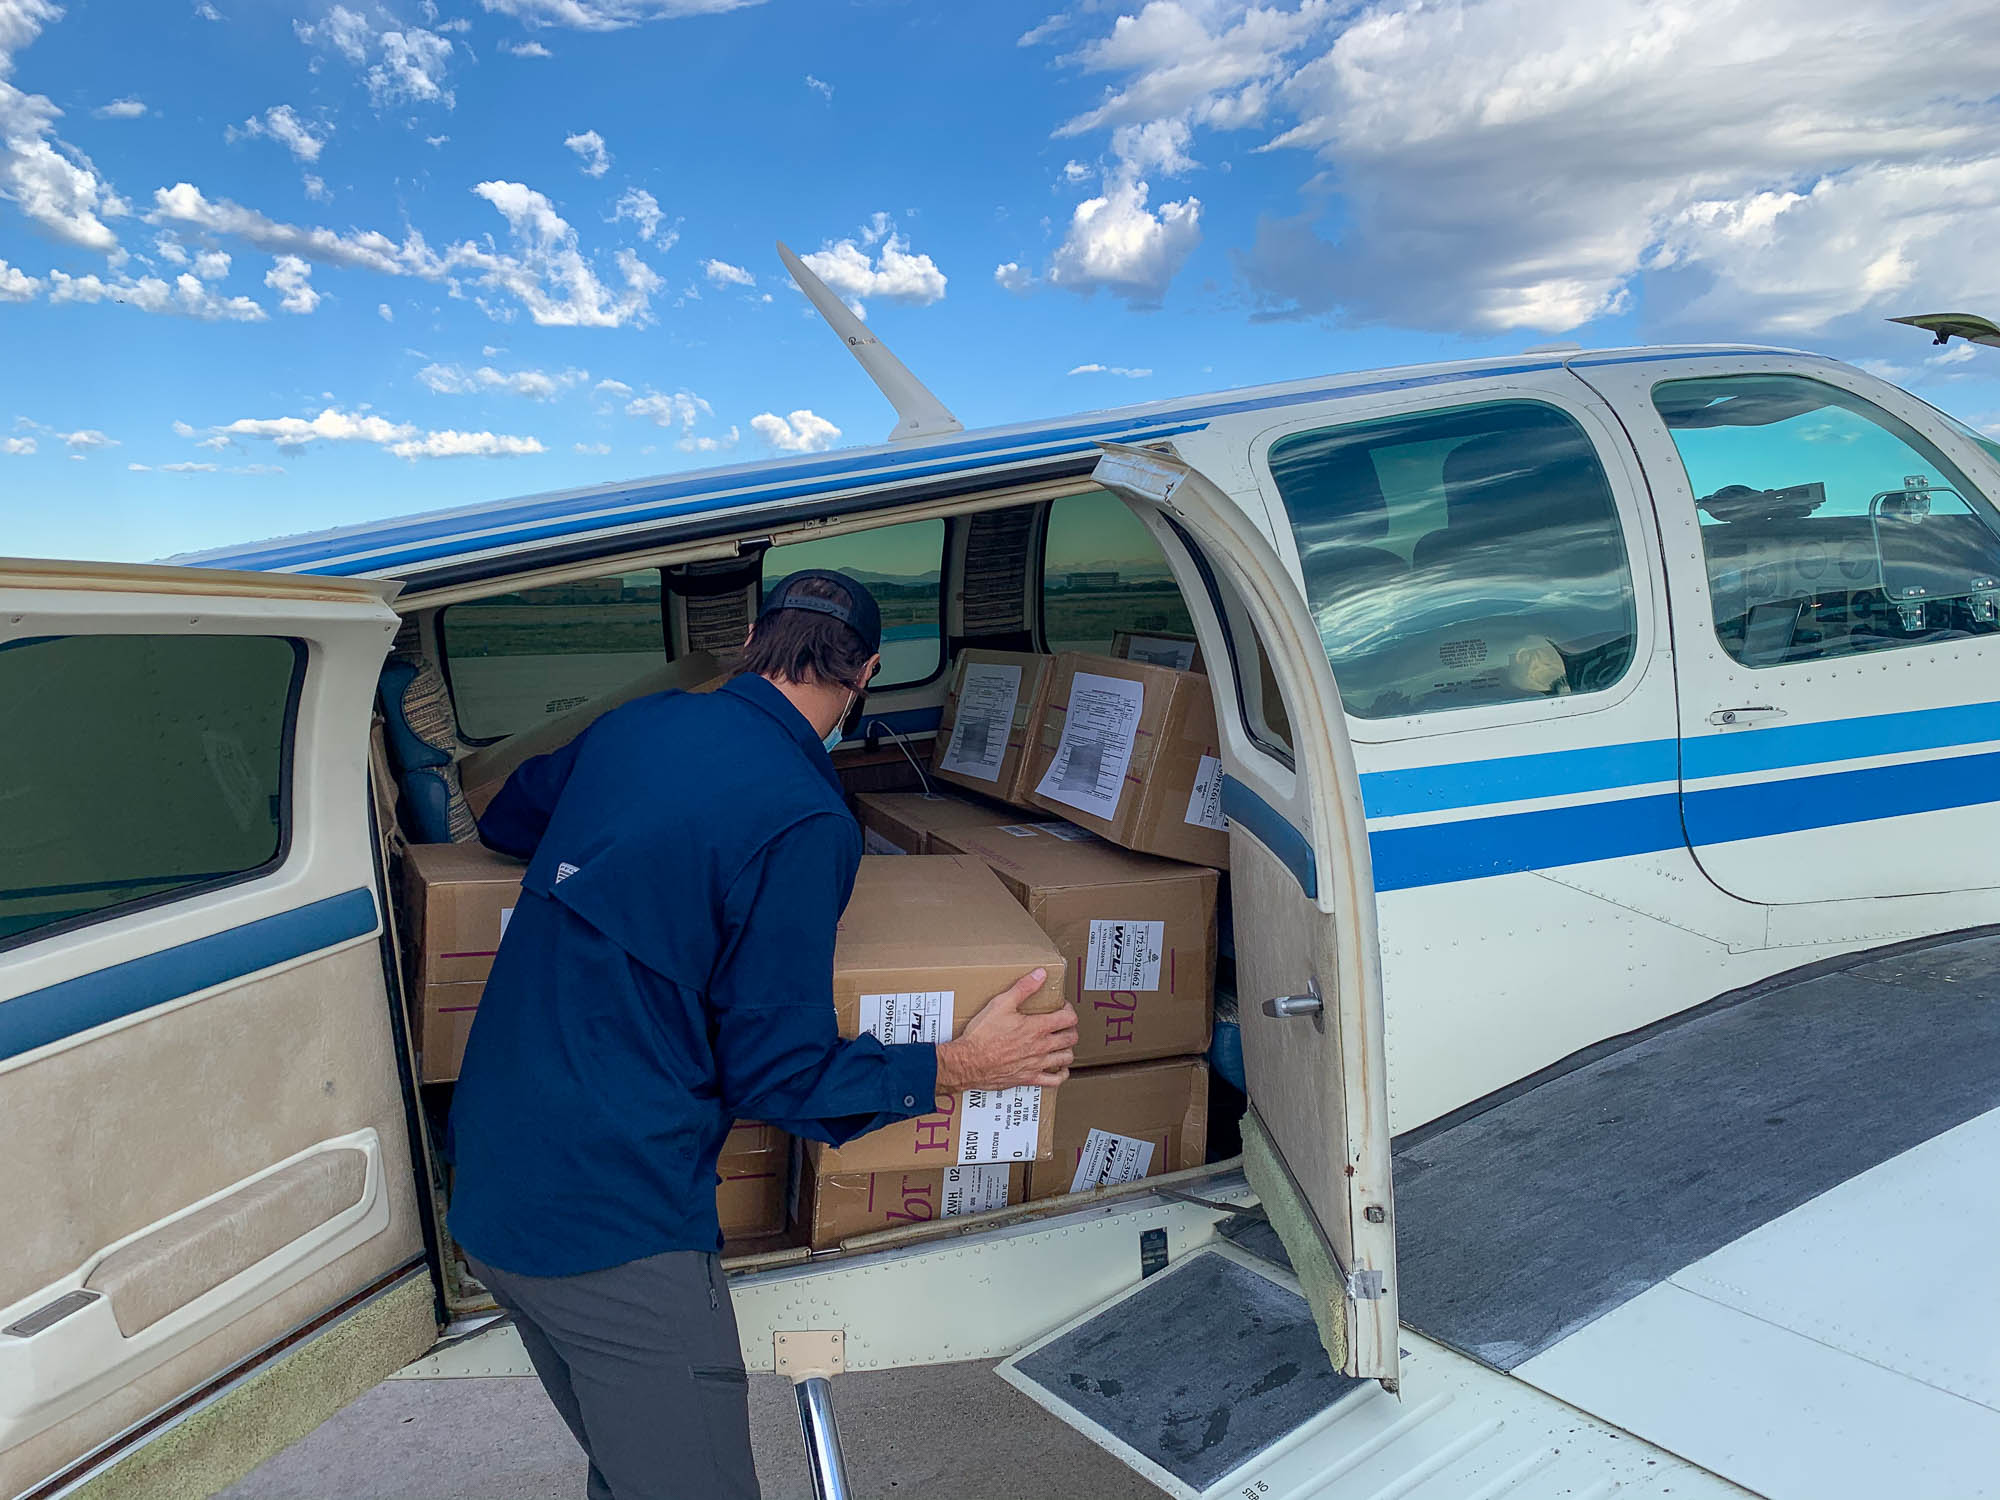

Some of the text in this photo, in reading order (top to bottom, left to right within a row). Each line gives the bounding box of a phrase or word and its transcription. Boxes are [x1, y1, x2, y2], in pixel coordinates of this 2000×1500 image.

[1132, 930, 1145, 986] 172-39294662
[1014, 1097, 1022, 1108] DZ
[1033, 1093, 1039, 1102] VL
[1013, 1110, 1022, 1126] 41/8
[965, 1131, 979, 1160] BEATCV
[946, 1168, 961, 1216] XWH 02
[1254, 1480, 1269, 1492] NO
